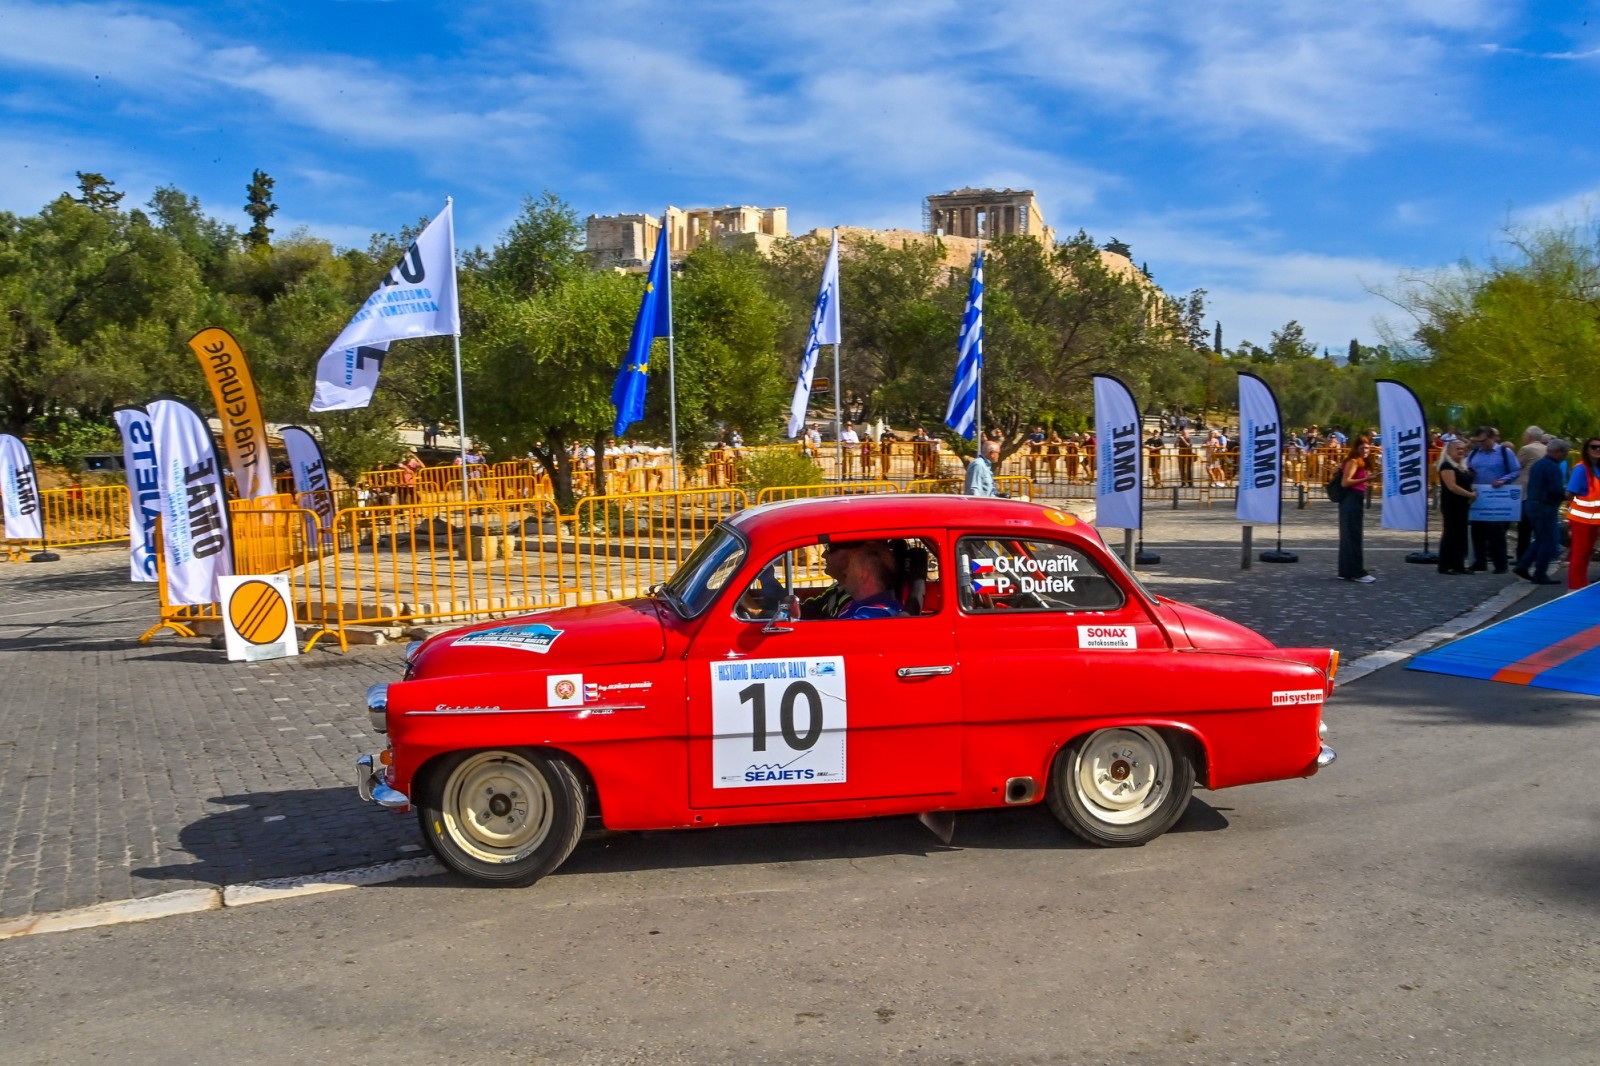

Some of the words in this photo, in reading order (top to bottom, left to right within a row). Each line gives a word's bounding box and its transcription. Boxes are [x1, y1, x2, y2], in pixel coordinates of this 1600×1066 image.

[997, 577, 1014, 594] P.
[1021, 576, 1075, 593] Dufek
[1087, 628, 1127, 638] SONAX
[718, 663, 748, 681] HISTORIC
[789, 661, 807, 679] RALLY
[738, 680, 823, 752] 10
[744, 769, 814, 782] SEAJETS
